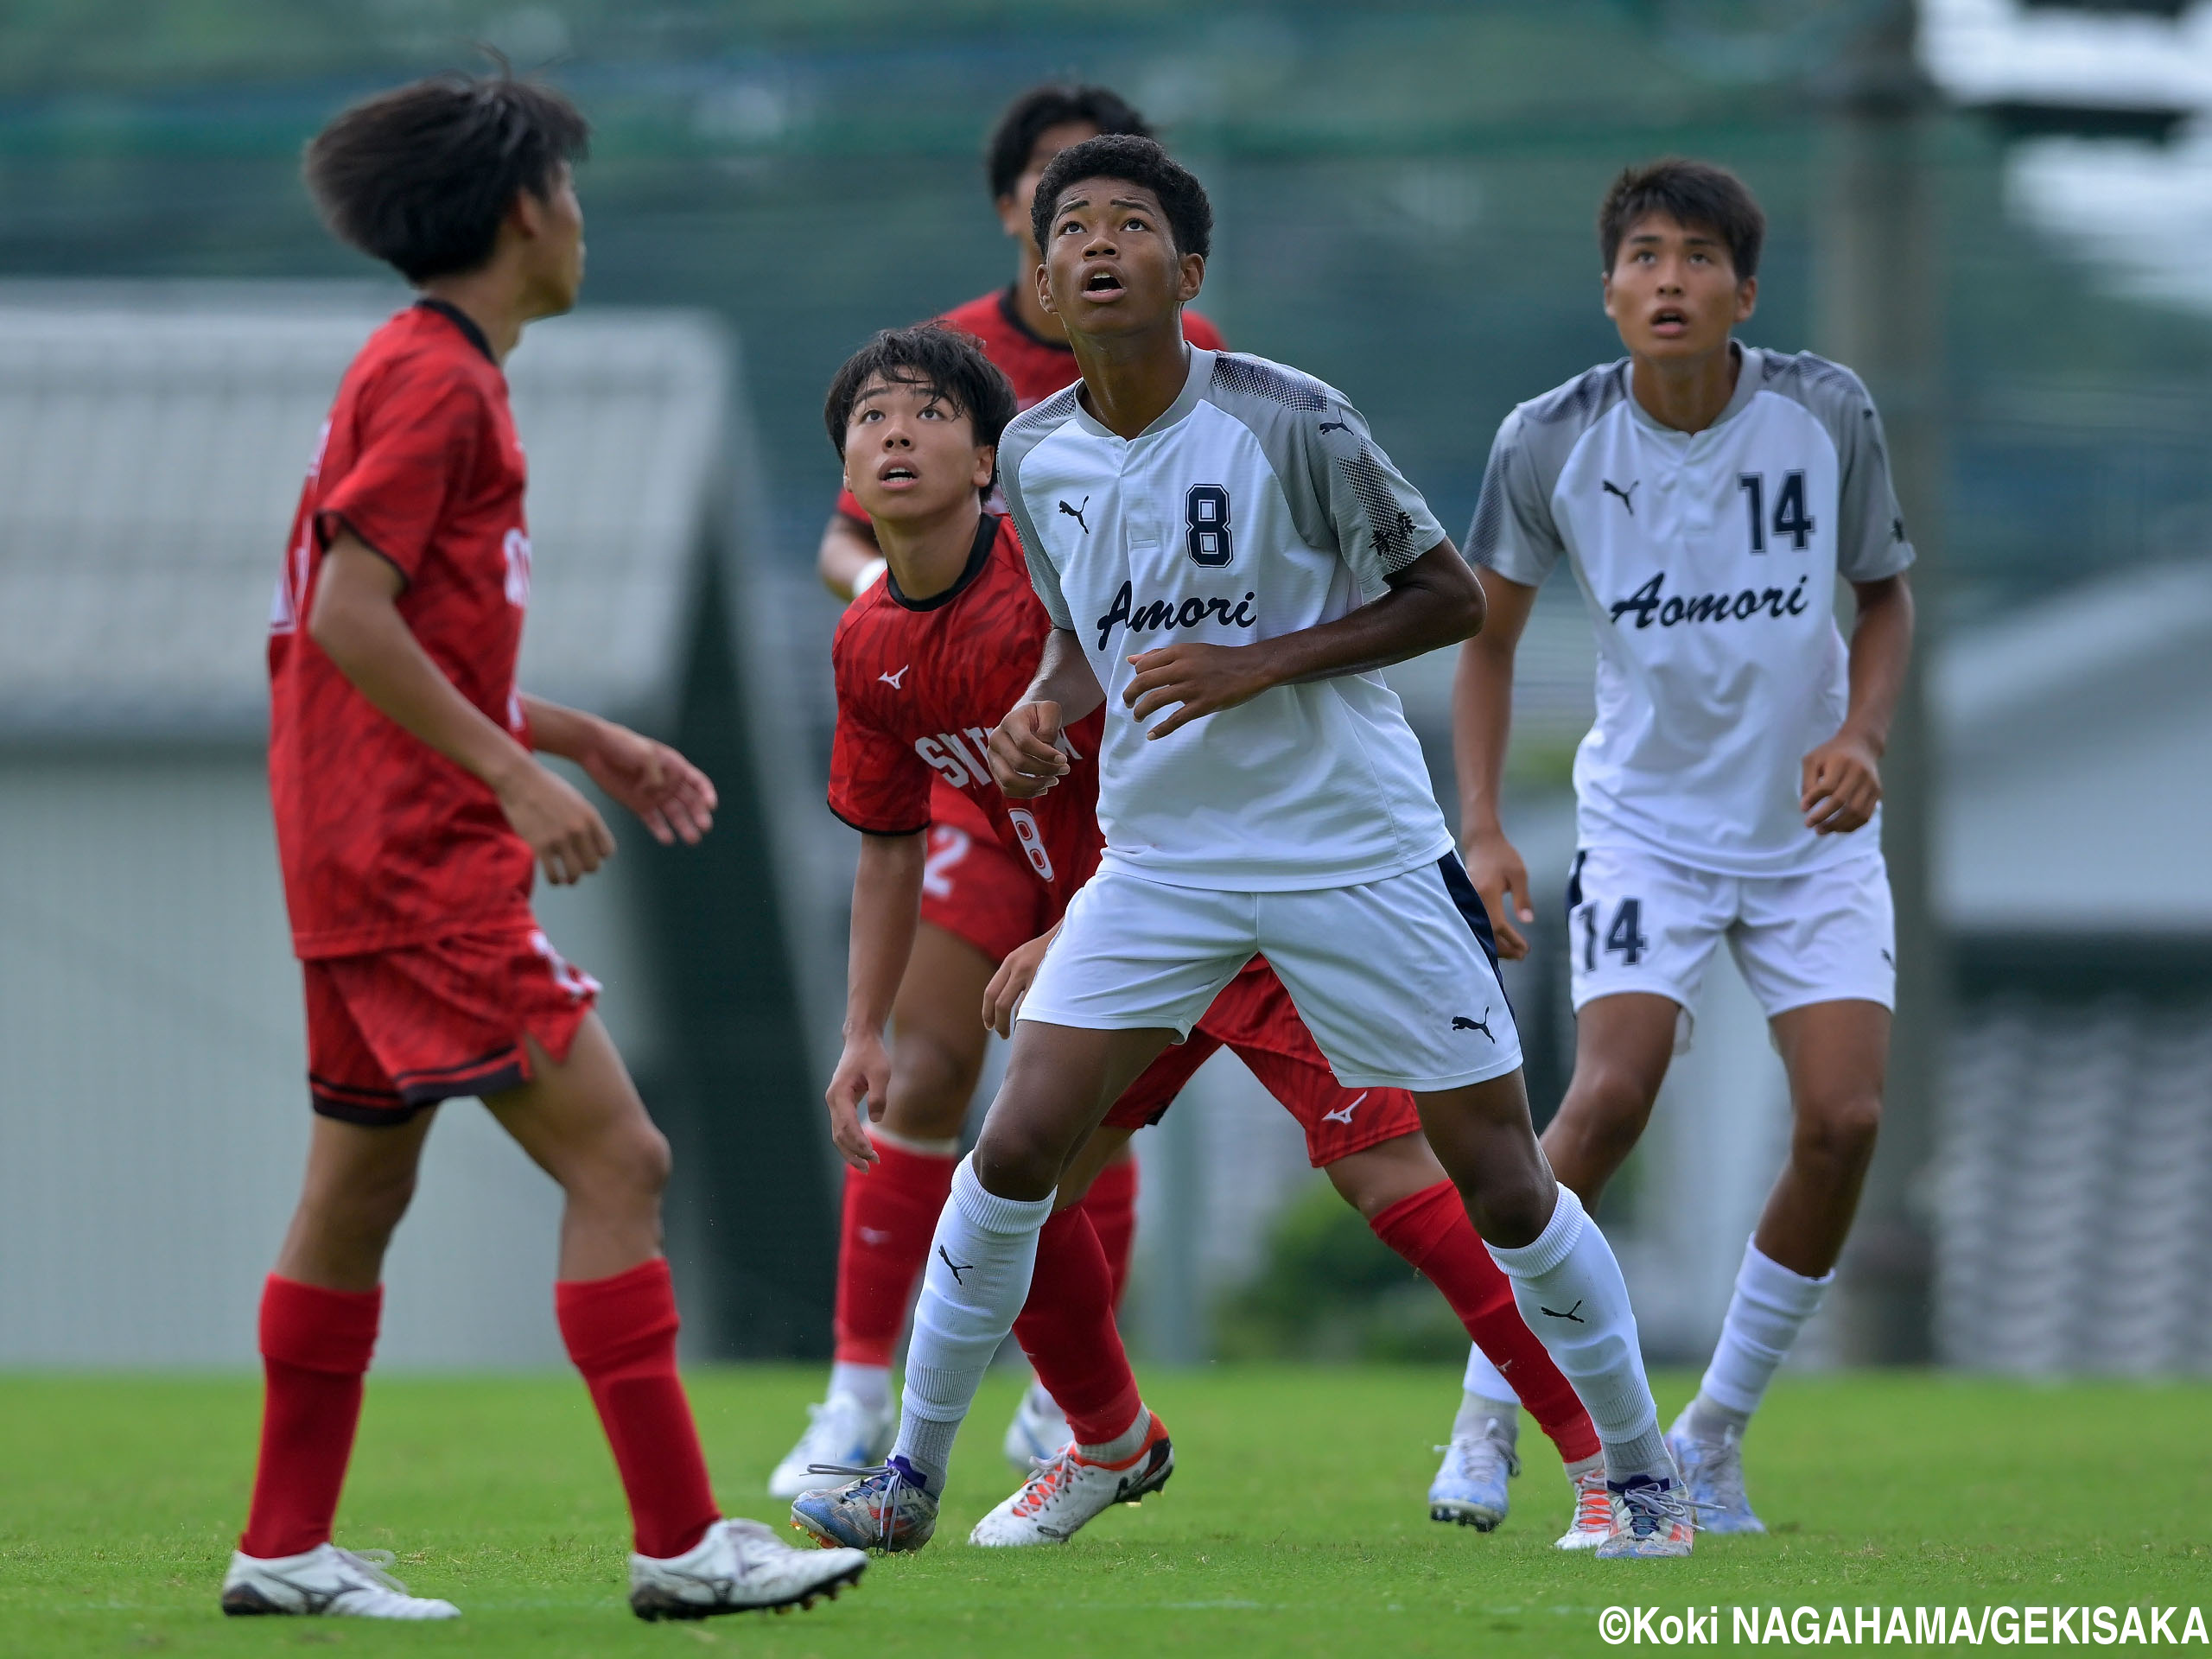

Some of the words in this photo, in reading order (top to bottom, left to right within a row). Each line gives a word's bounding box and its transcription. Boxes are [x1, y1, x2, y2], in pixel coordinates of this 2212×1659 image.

[1185, 483, 1234, 569] 8
[1738, 469, 1815, 555] 14
[1096, 580, 1257, 652] Amori
[1611, 570, 1808, 629] Aomori
[1007, 807, 1055, 882] 8
[1578, 895, 1648, 974] 14
